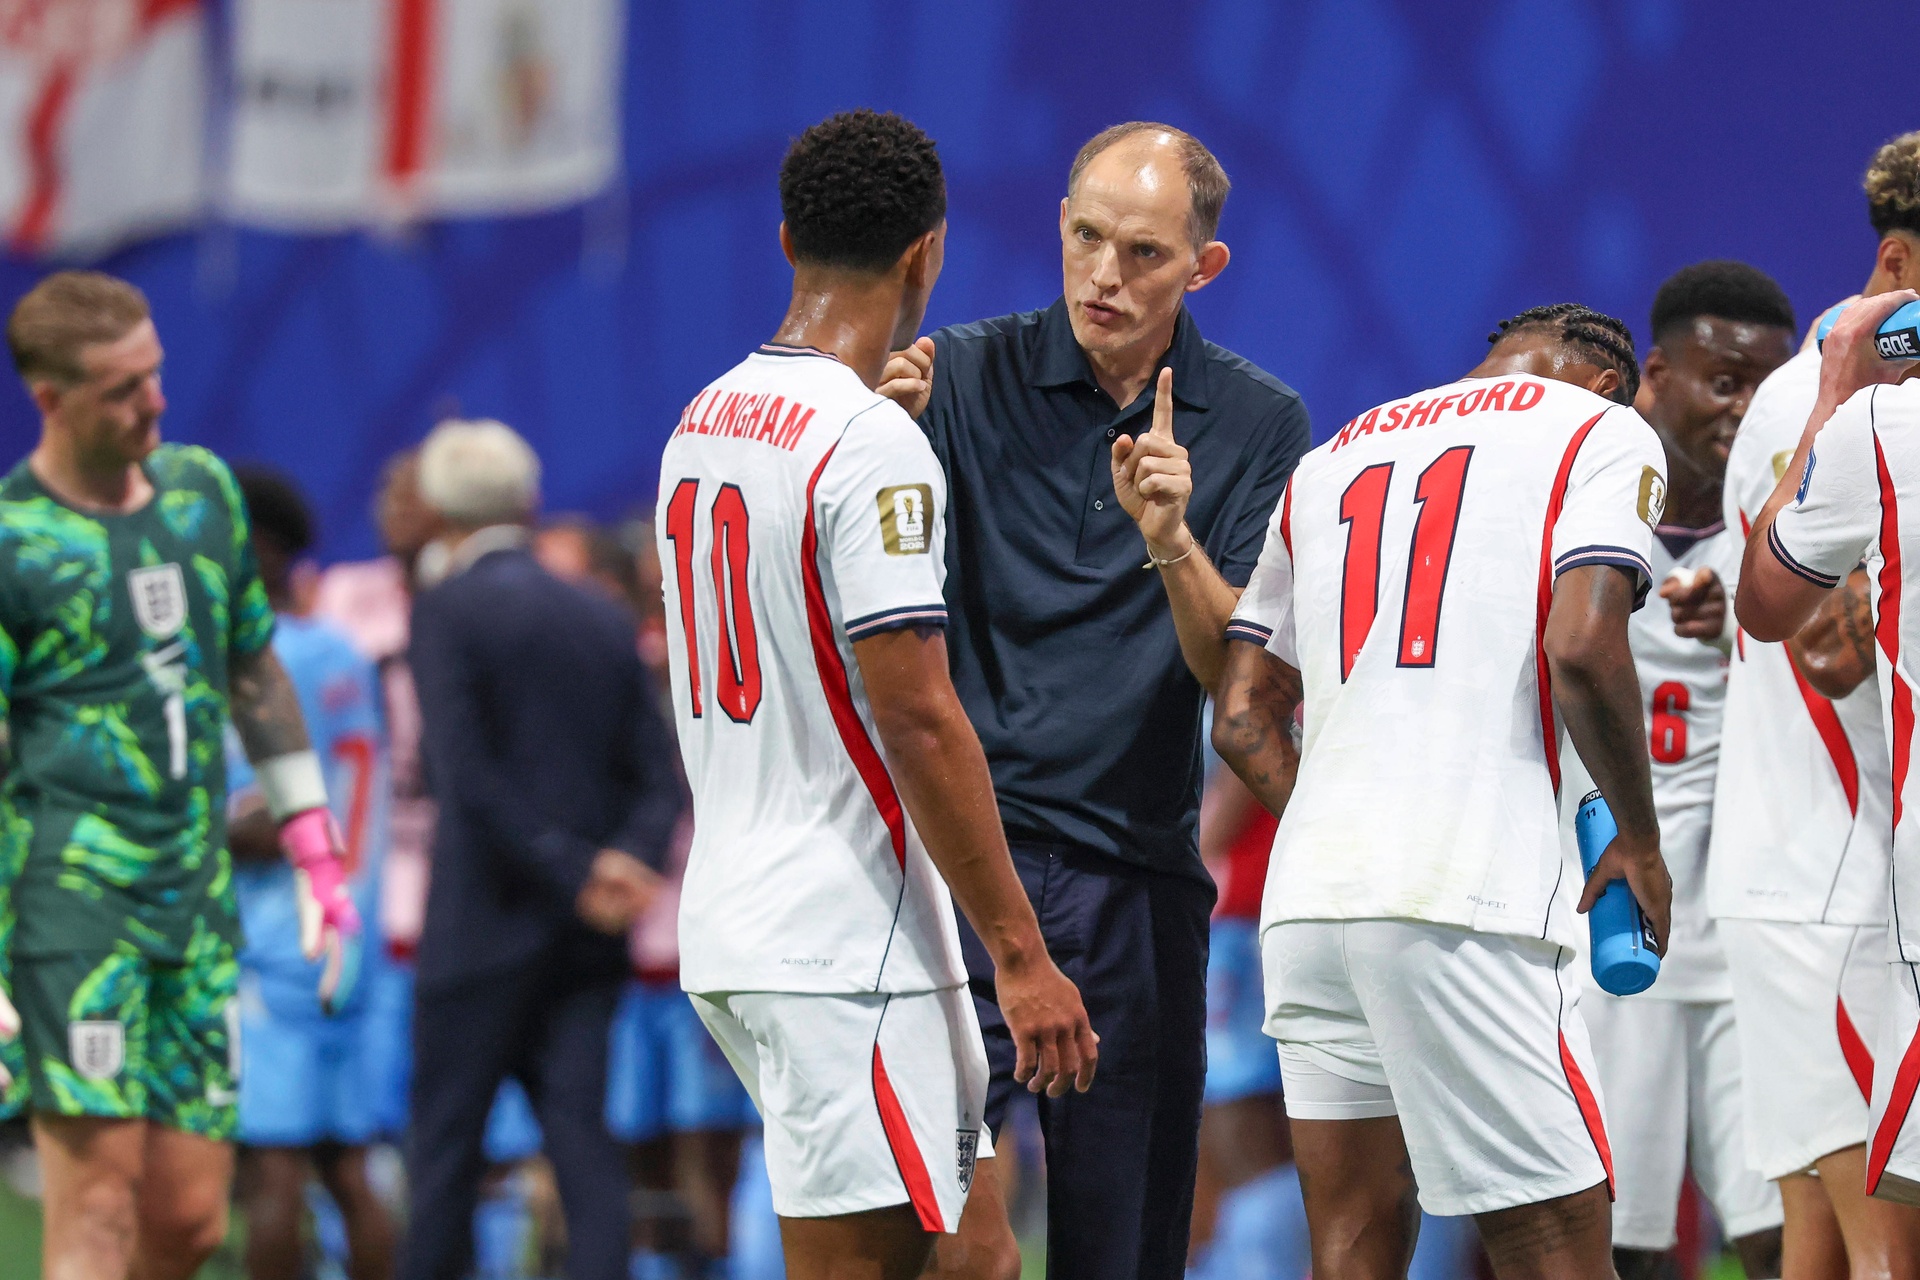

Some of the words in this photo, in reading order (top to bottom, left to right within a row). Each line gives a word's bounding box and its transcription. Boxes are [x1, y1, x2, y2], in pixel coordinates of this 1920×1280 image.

[674, 389, 817, 452] LLINGHAM
[1330, 381, 1545, 453] RASHFORD
[666, 478, 763, 725] 10
[1339, 445, 1475, 684] 11
[165, 692, 188, 781] 1
[1651, 680, 1690, 764] 6
[1585, 806, 1597, 820] 11
[780, 957, 835, 966] AERO-FIT
